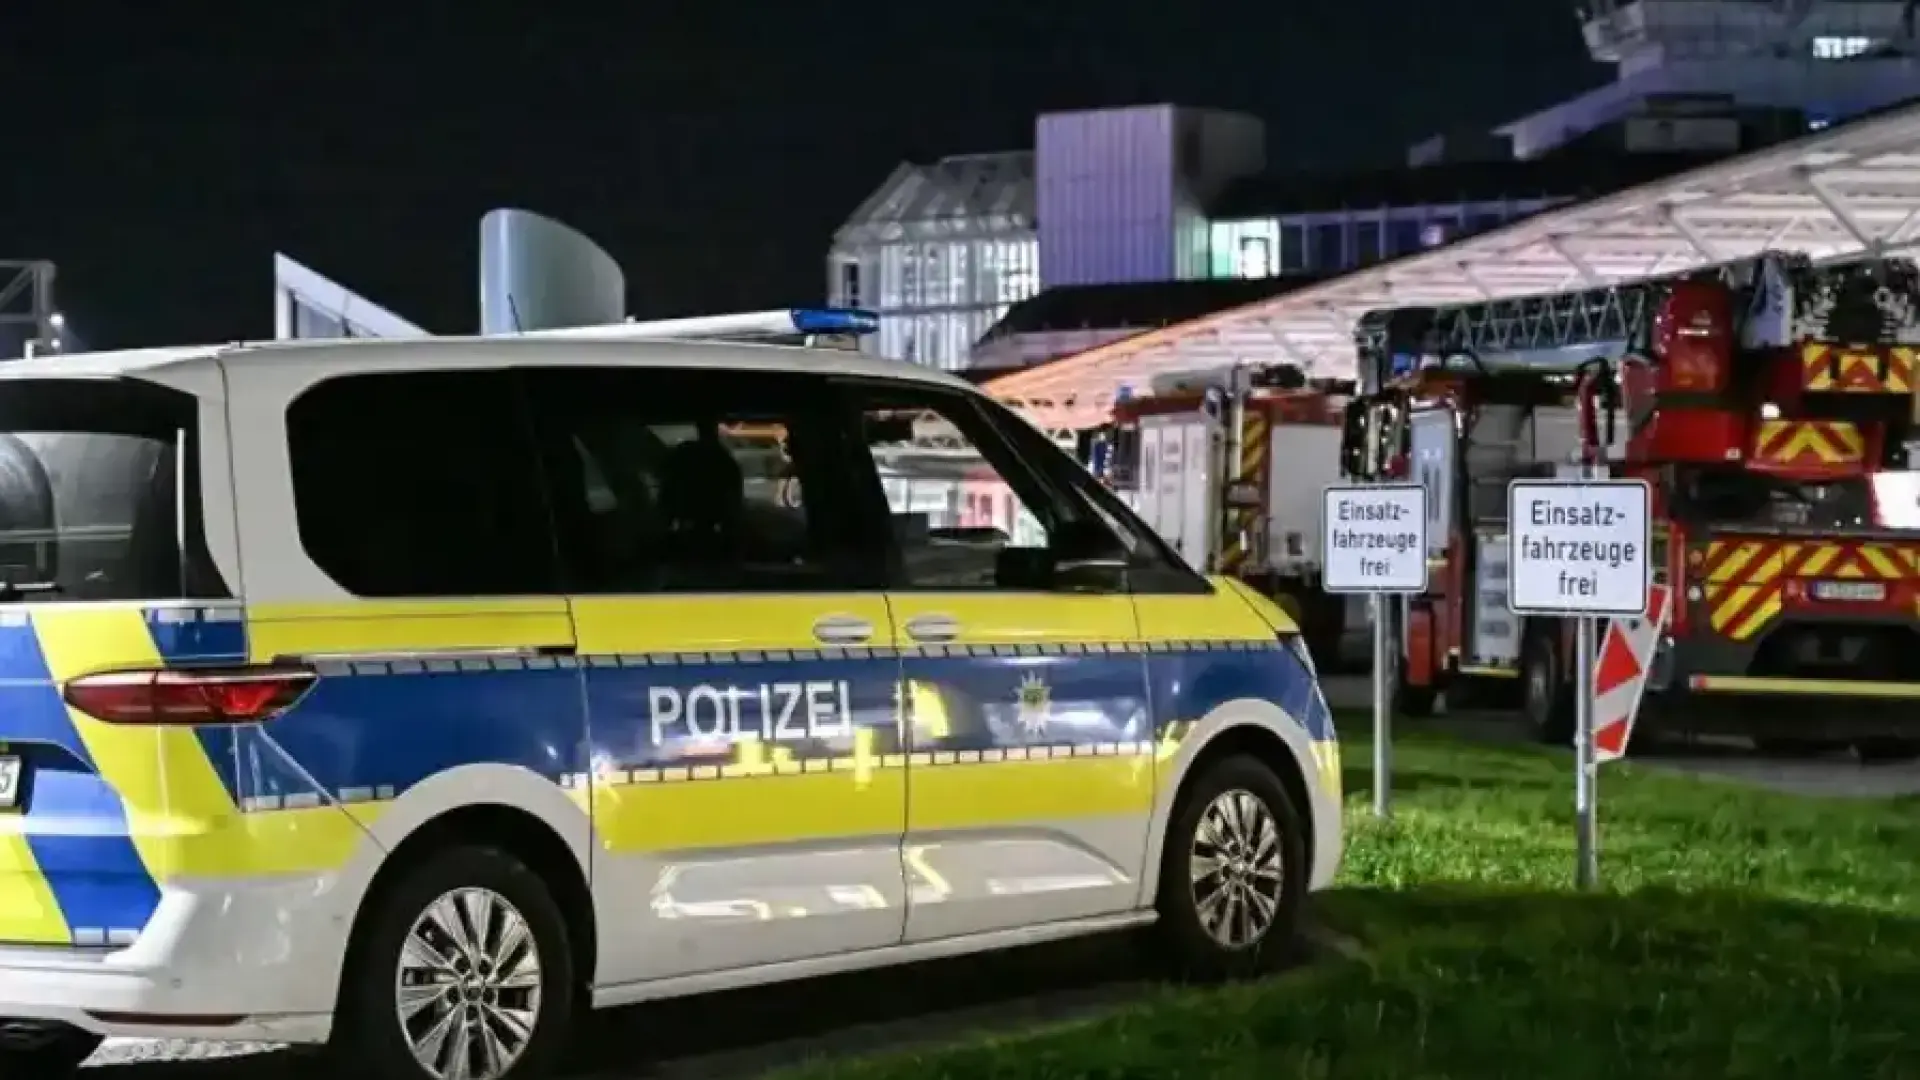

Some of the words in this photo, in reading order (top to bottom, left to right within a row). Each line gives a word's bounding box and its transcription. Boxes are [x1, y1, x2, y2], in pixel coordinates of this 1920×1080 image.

[1338, 501, 1410, 521] Einsatz-
[1531, 500, 1626, 525] Einsatz-
[1333, 529, 1417, 552] fahrzeuge
[1522, 535, 1636, 567] fahrzeuge
[1360, 557, 1391, 576] frei
[1559, 570, 1598, 596] frei
[649, 680, 852, 746] POLIZEI
